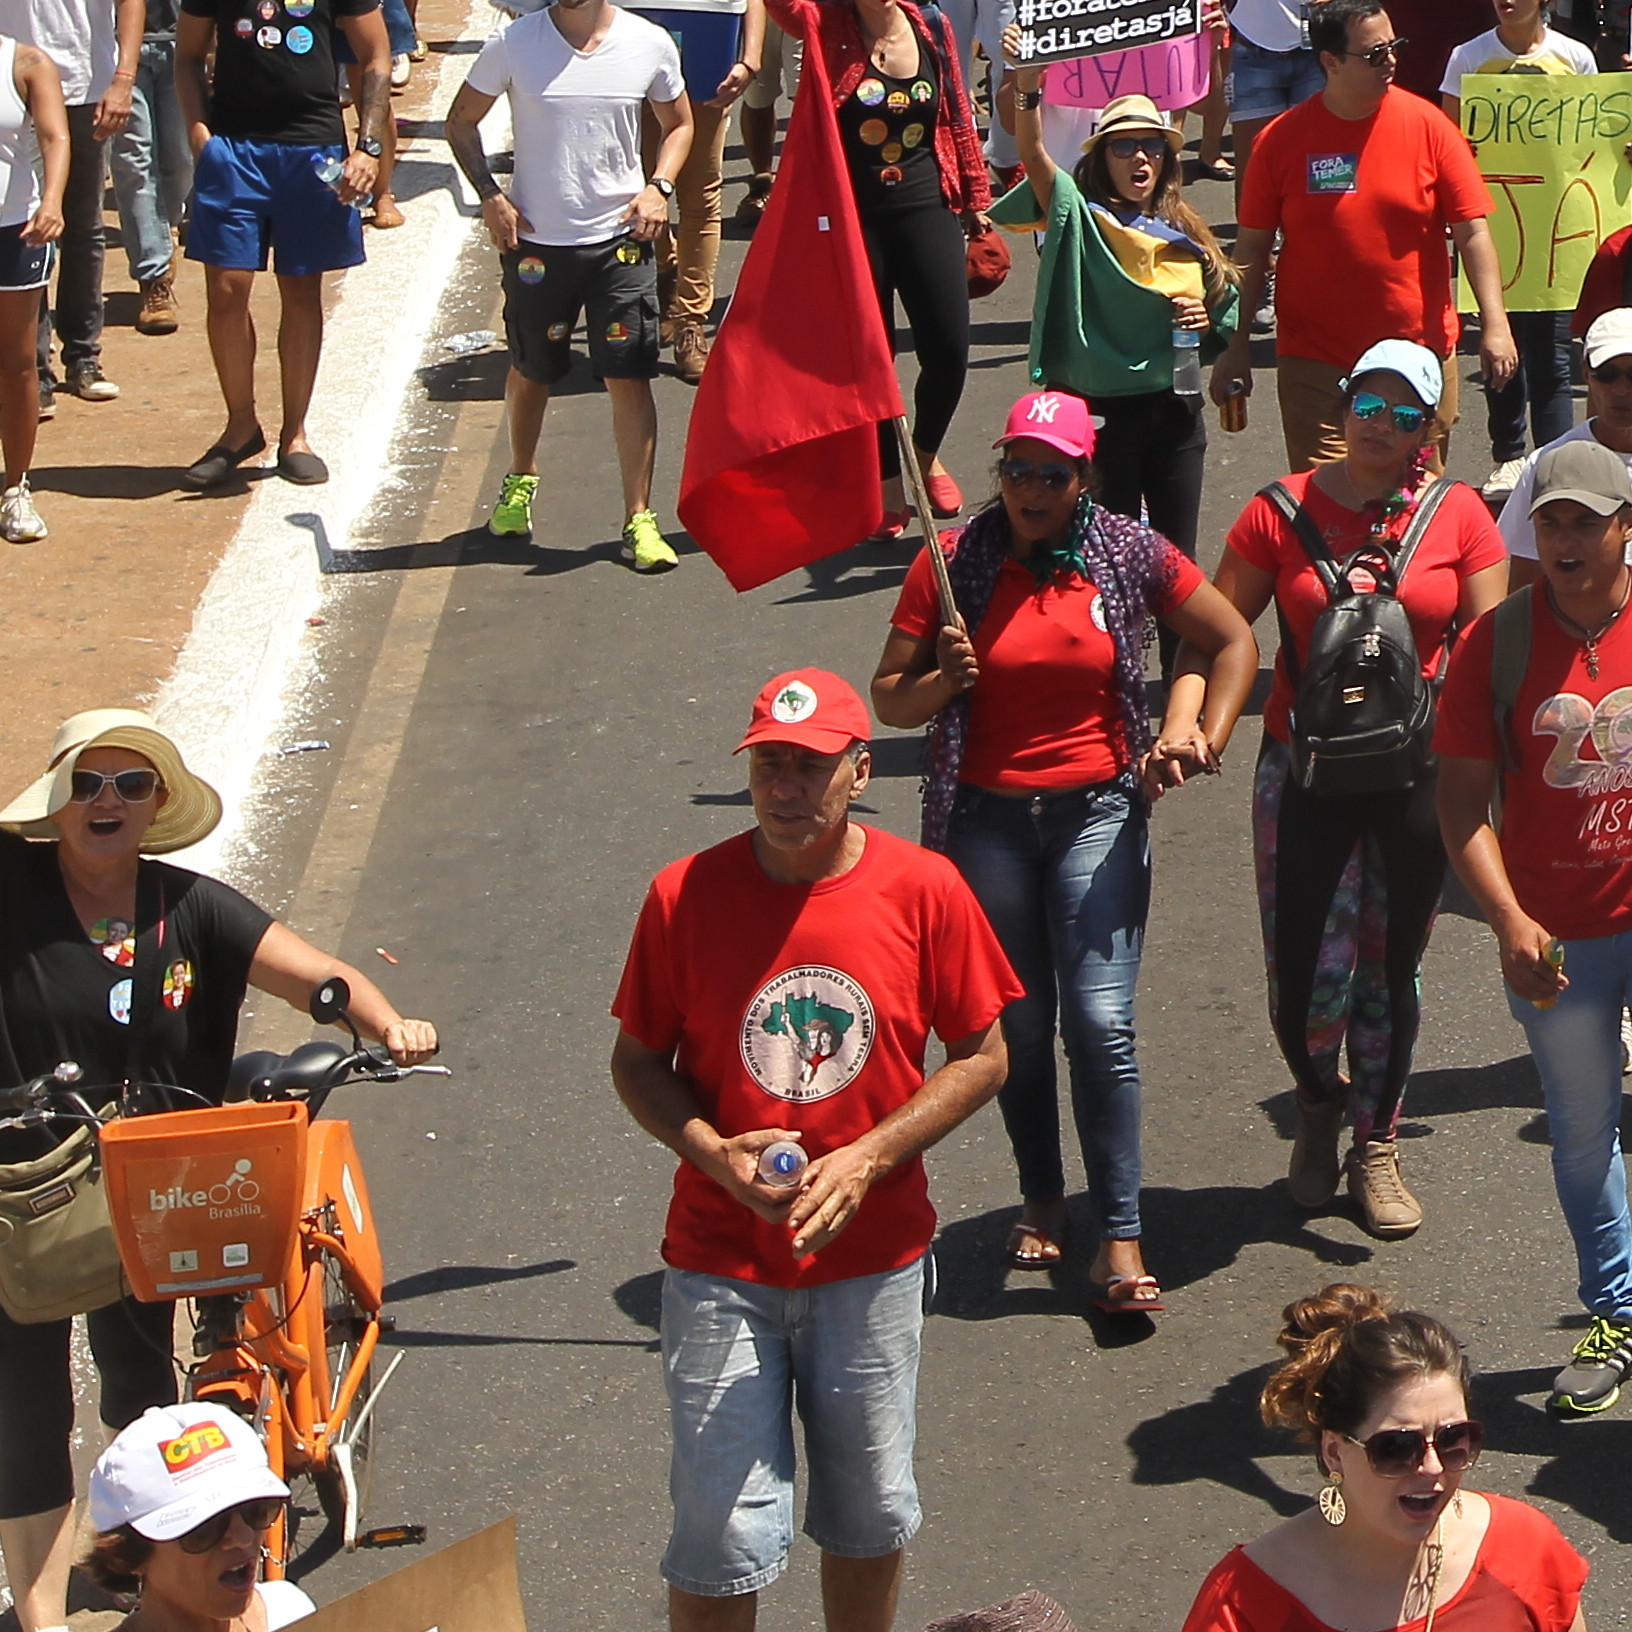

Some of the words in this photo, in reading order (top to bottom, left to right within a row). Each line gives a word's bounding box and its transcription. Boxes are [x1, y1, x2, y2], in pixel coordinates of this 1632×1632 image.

[1311, 156, 1345, 170] FORA
[1311, 165, 1354, 180] TEMER
[764, 969, 846, 998] TRABALHADORES
[749, 997, 766, 1018] DOS
[844, 984, 871, 1017] RURAIS
[743, 1019, 764, 1077] MOVIMENTO
[847, 1040, 870, 1073] TERRA
[783, 1087, 823, 1099] BRASIL
[149, 1188, 209, 1212] bike
[163, 1425, 227, 1466] CTB
